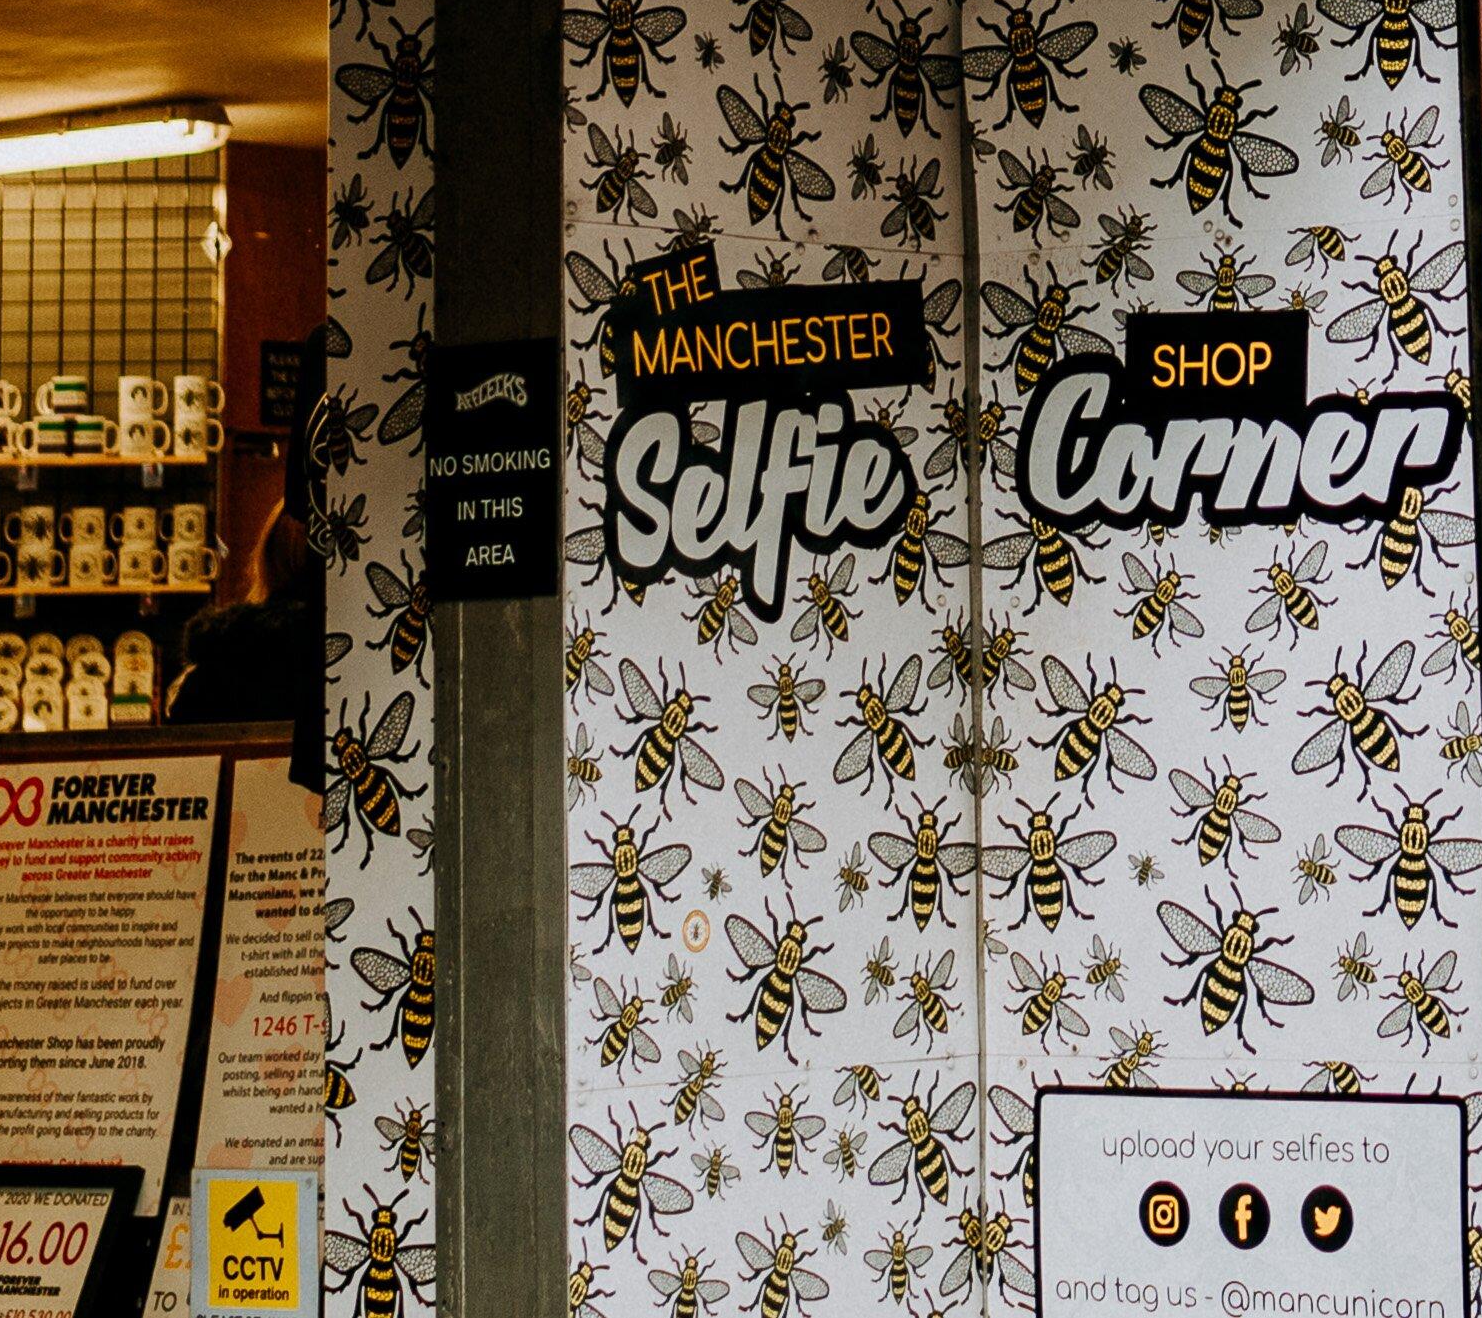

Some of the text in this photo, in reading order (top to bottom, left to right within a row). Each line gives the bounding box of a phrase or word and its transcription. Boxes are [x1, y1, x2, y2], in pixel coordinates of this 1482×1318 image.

[641, 256, 715, 316] THE
[633, 311, 895, 378] MANCHESTER
[1151, 341, 1273, 388] SHOP
[1028, 371, 1450, 515] Corner
[429, 447, 551, 477] NO SMOKING
[457, 496, 524, 521] IN THIS
[616, 398, 906, 607] Selfie
[465, 543, 516, 567] AREA
[51, 773, 157, 799] FOREVER
[46, 796, 209, 825] MANCHESTER
[27, 836, 85, 850] Manchester
[86, 835, 95, 847] is
[97, 838, 104, 847] a
[105, 835, 140, 850] charity
[141, 834, 162, 846] that
[163, 834, 194, 846] raises
[12, 853, 22, 865] to
[24, 852, 46, 865] fund
[48, 852, 67, 865] and
[68, 852, 107, 868] support
[107, 850, 163, 864] community
[164, 849, 202, 863] activity
[235, 847, 308, 865] The events of
[21, 867, 153, 881] across Greater Manchester
[229, 867, 308, 883] for the Manc &
[253, 1015, 298, 1036] 1246
[47, 1035, 74, 1051] Shop
[75, 1035, 95, 1049] has
[96, 1035, 123, 1049] been
[124, 1035, 166, 1052] proudly
[29, 1056, 57, 1069] them
[58, 1056, 87, 1068] since
[88, 1055, 116, 1069] June
[117, 1055, 147, 1069] 2018.
[1101, 1130, 1390, 1167] upload your selfies to
[5, 1191, 31, 1205] 2020
[34, 1192, 51, 1205] WE
[52, 1192, 110, 1206] DONATED
[222, 1254, 284, 1282] CCTV
[218, 1284, 290, 1303] in operation
[1055, 1274, 1107, 1304] and
[1115, 1277, 1159, 1313] tag
[1167, 1284, 1197, 1309] us
[1220, 1279, 1445, 1318] @mancunicorn
